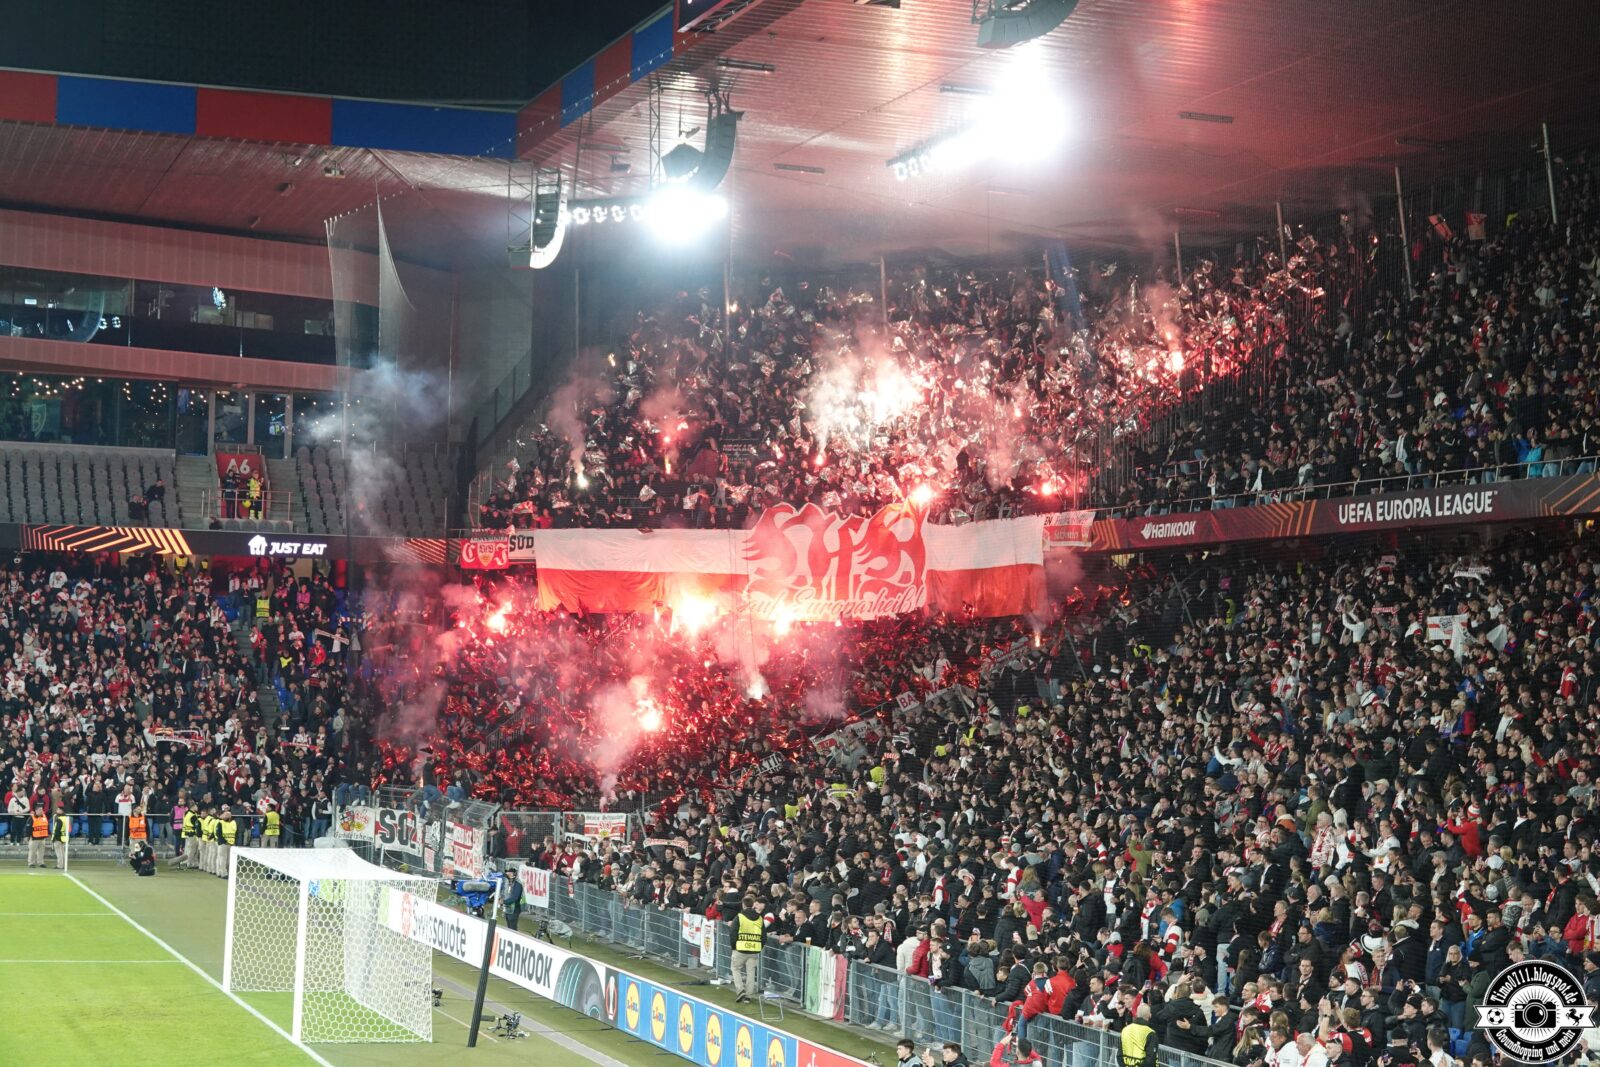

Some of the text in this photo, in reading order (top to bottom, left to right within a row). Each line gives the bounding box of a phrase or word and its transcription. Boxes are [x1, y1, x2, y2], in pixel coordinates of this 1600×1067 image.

[226, 458, 250, 474] A6
[1338, 502, 1374, 524] UEFA
[1376, 497, 1432, 522] EUROPA
[269, 542, 327, 554] JUST EAT
